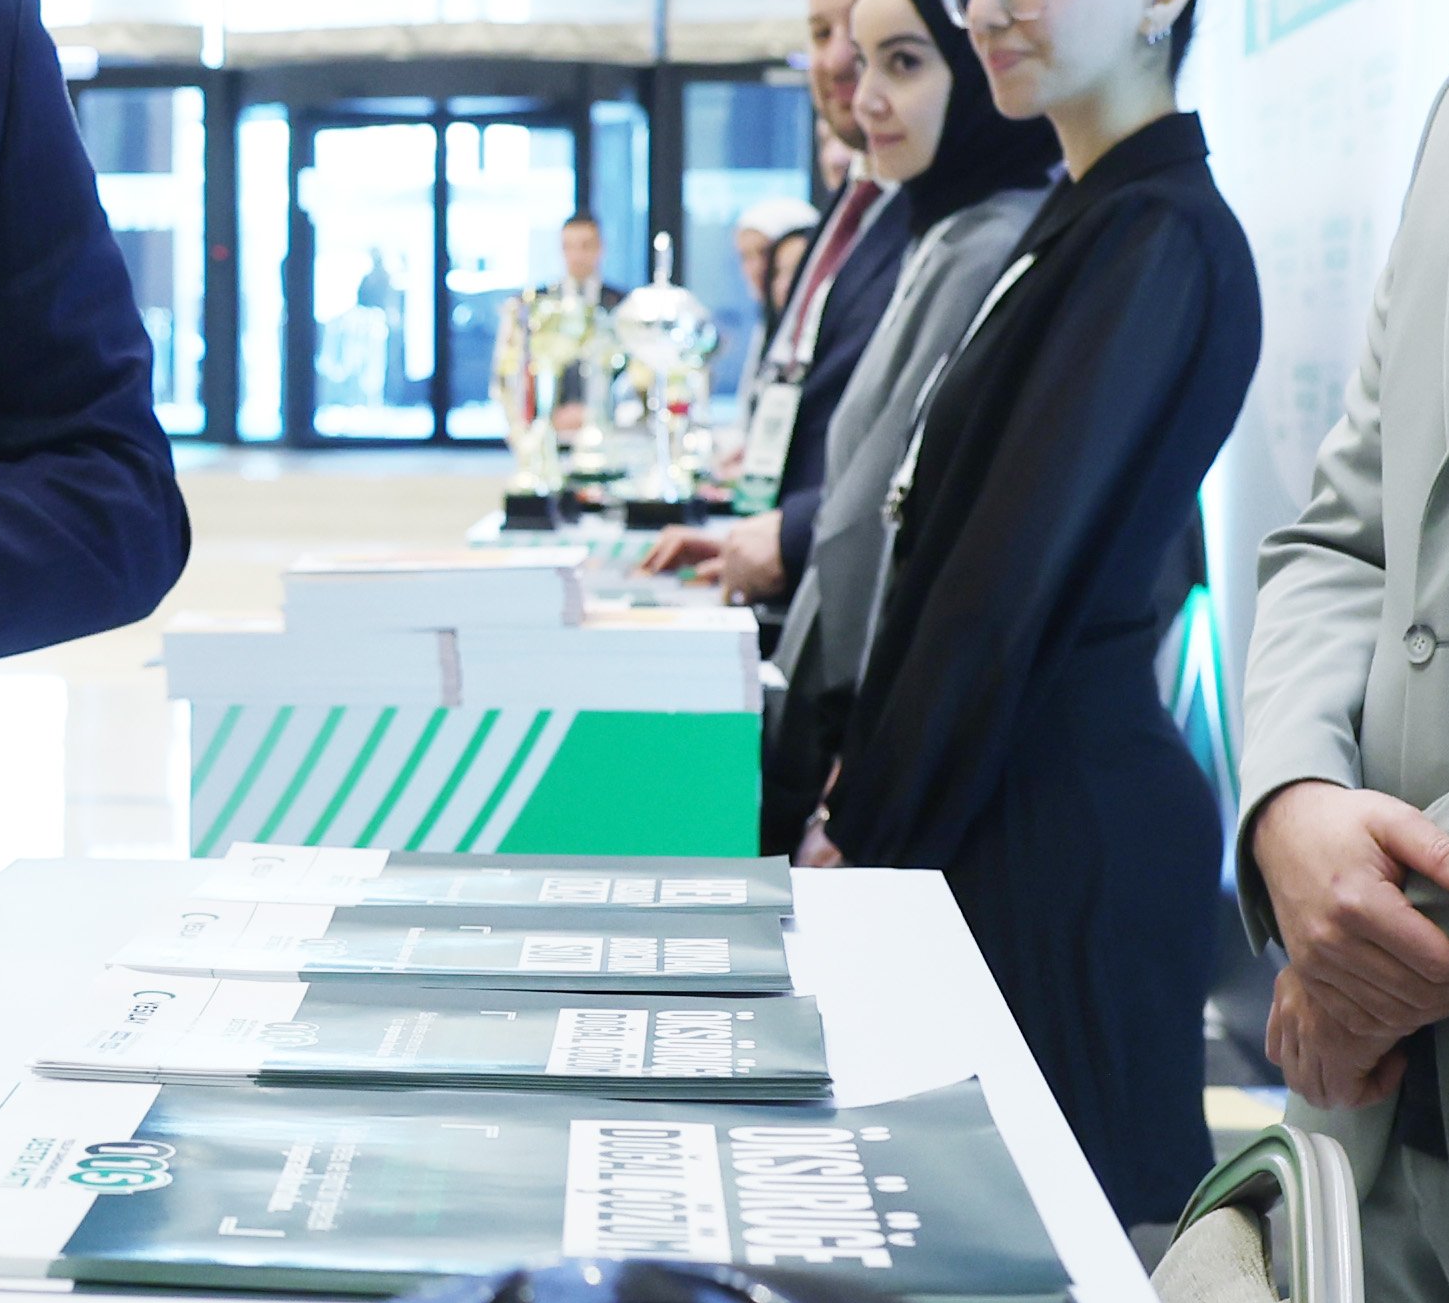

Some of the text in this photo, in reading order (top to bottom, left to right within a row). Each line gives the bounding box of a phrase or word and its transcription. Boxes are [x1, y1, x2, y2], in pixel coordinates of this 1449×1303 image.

[527, 943, 594, 965] SON
[664, 939, 730, 974] KUMAR
[570, 1012, 635, 1044] DOĞAL
[651, 1010, 756, 1078] ÖKSÜRÜĞE
[81, 1145, 160, 1184] 115
[597, 1127, 704, 1182] DOĞAL
[729, 1126, 920, 1269] ÖKSÜRÜĞE
